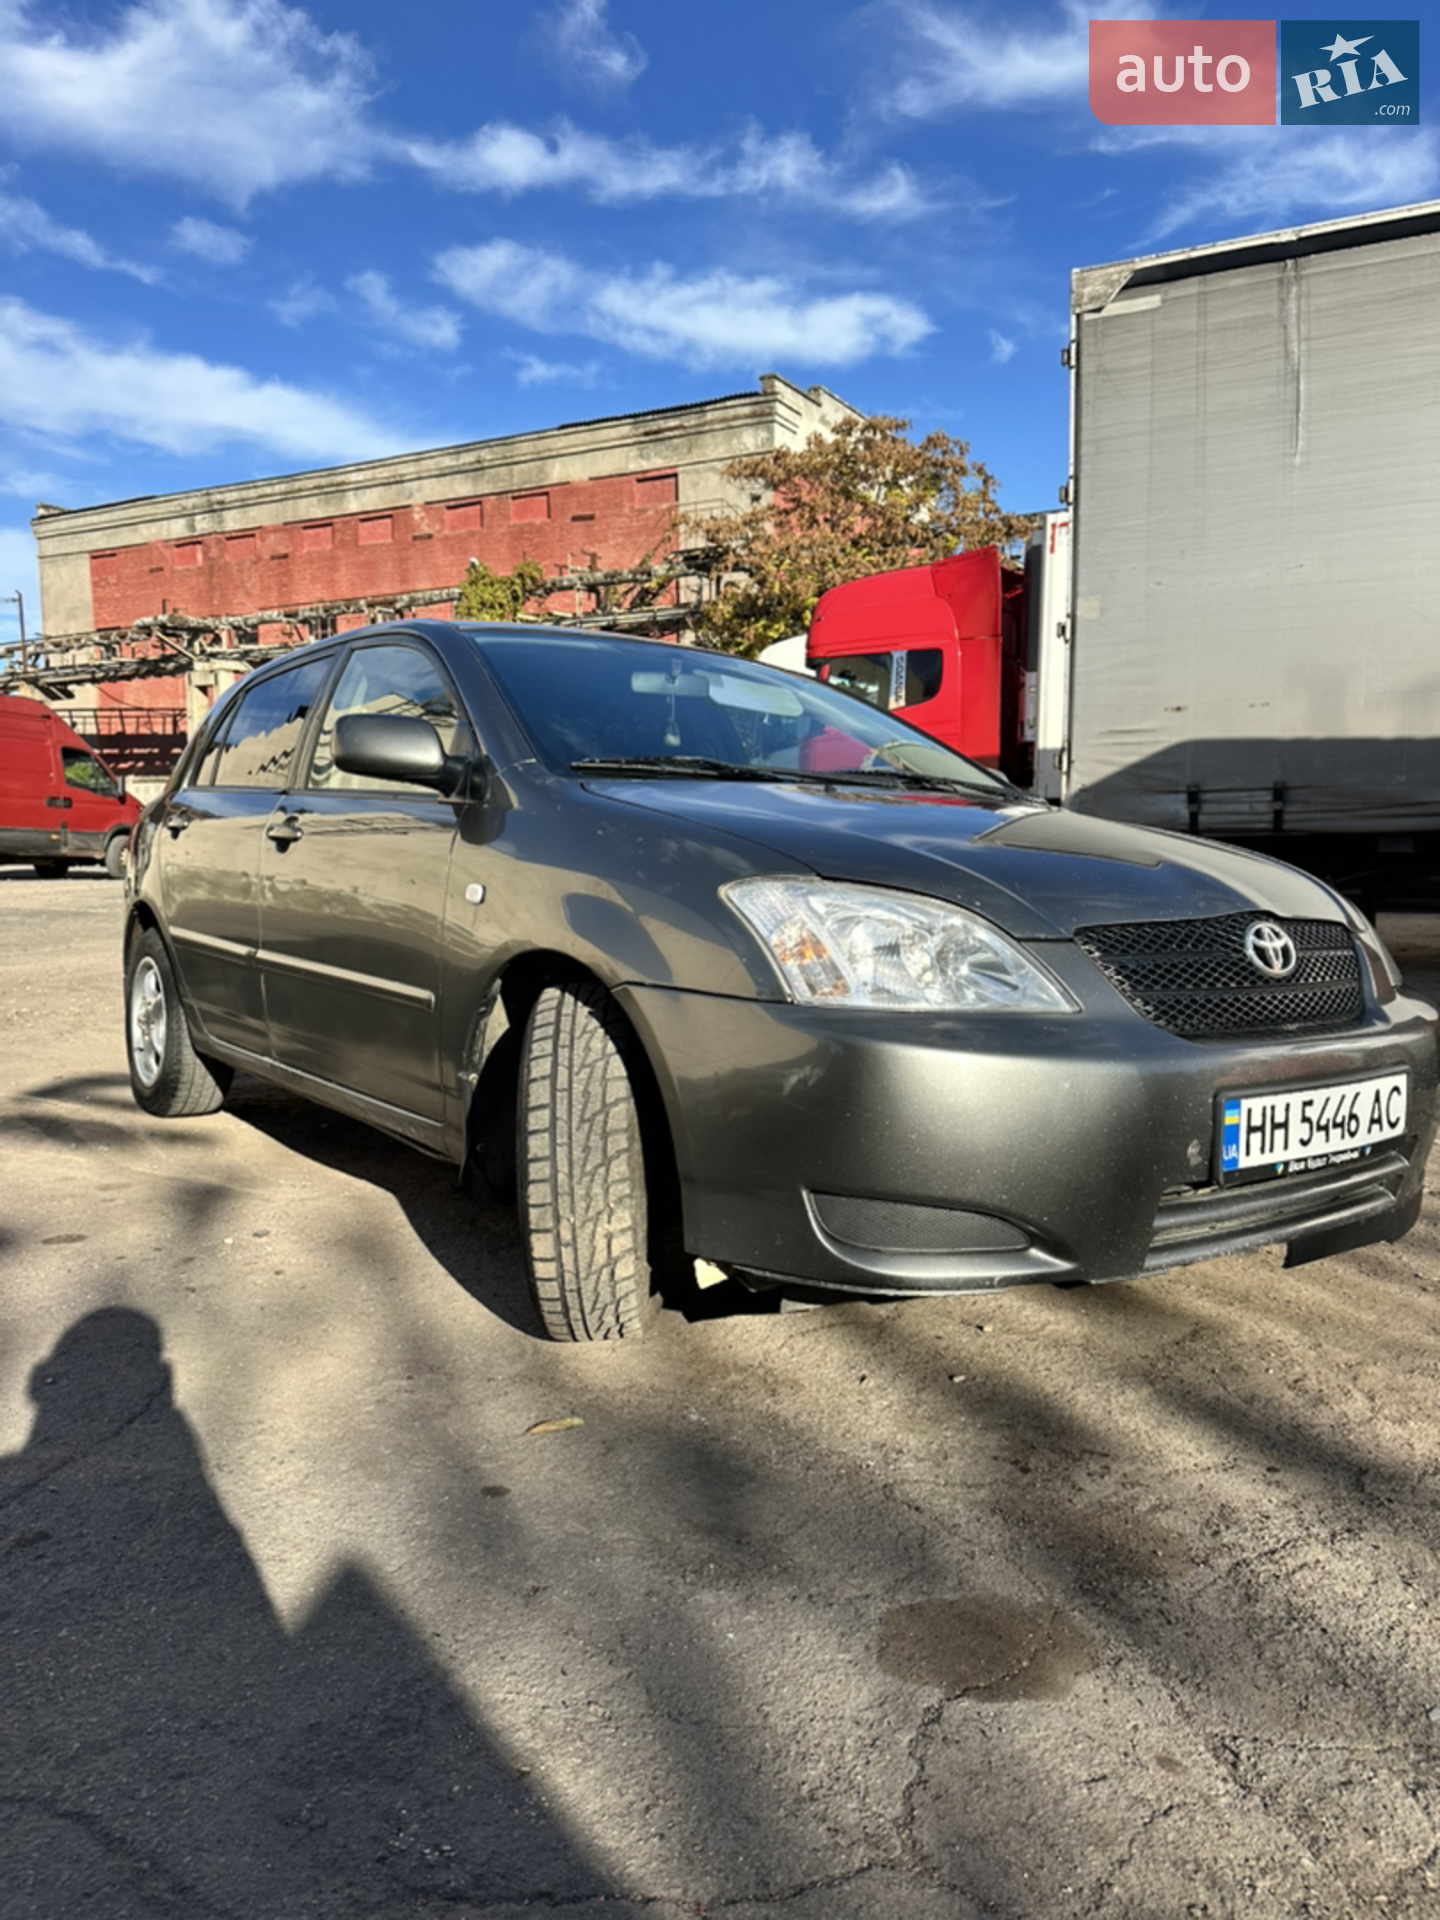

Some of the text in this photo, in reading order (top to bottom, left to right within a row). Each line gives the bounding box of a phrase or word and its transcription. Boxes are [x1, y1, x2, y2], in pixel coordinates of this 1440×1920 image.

[1246, 1085, 1402, 1157] HH 5446 AC
[1223, 1144, 1238, 1161] UA
